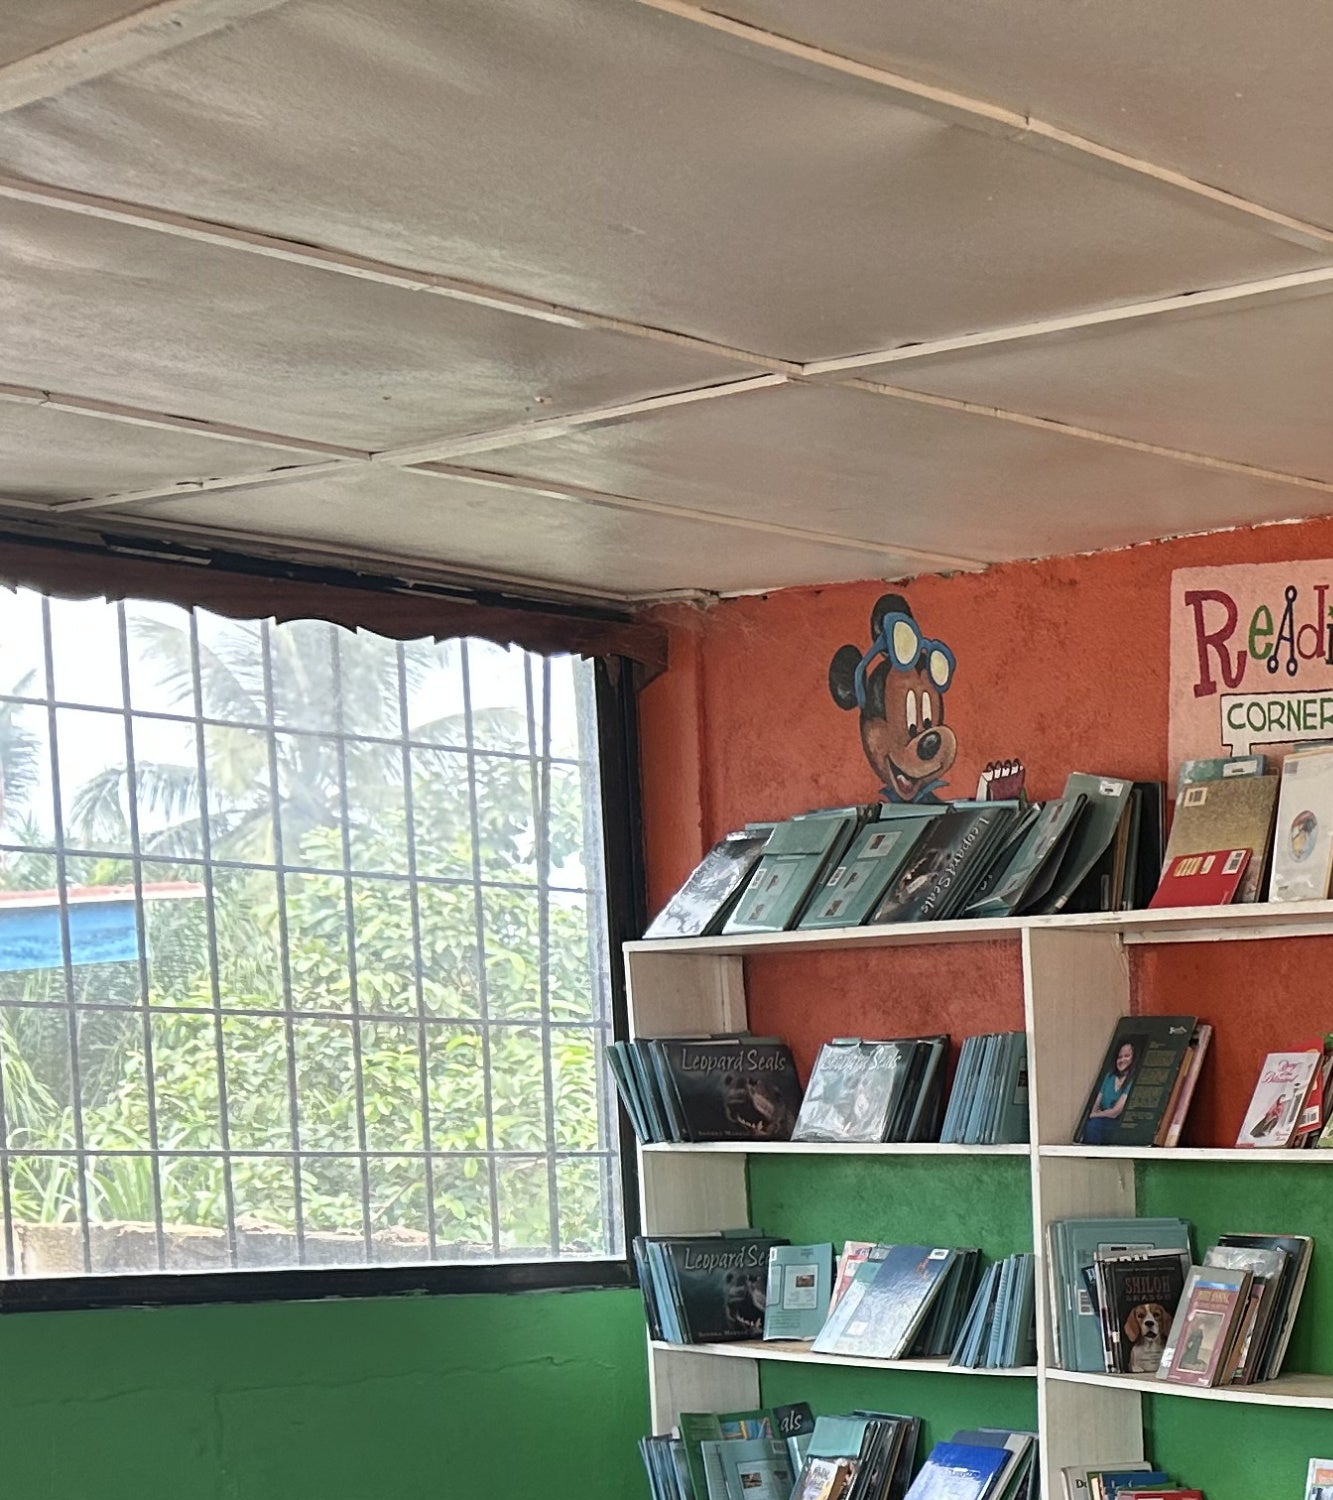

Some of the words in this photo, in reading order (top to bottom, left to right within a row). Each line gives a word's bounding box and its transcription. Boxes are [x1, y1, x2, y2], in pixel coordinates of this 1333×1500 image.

[944, 816, 990, 876] Leopard
[919, 874, 951, 914] Seals
[682, 1048, 744, 1074] Leopard
[747, 1050, 786, 1071] Seals
[684, 1247, 745, 1271] Leopard
[1125, 1276, 1171, 1293] SHILOH
